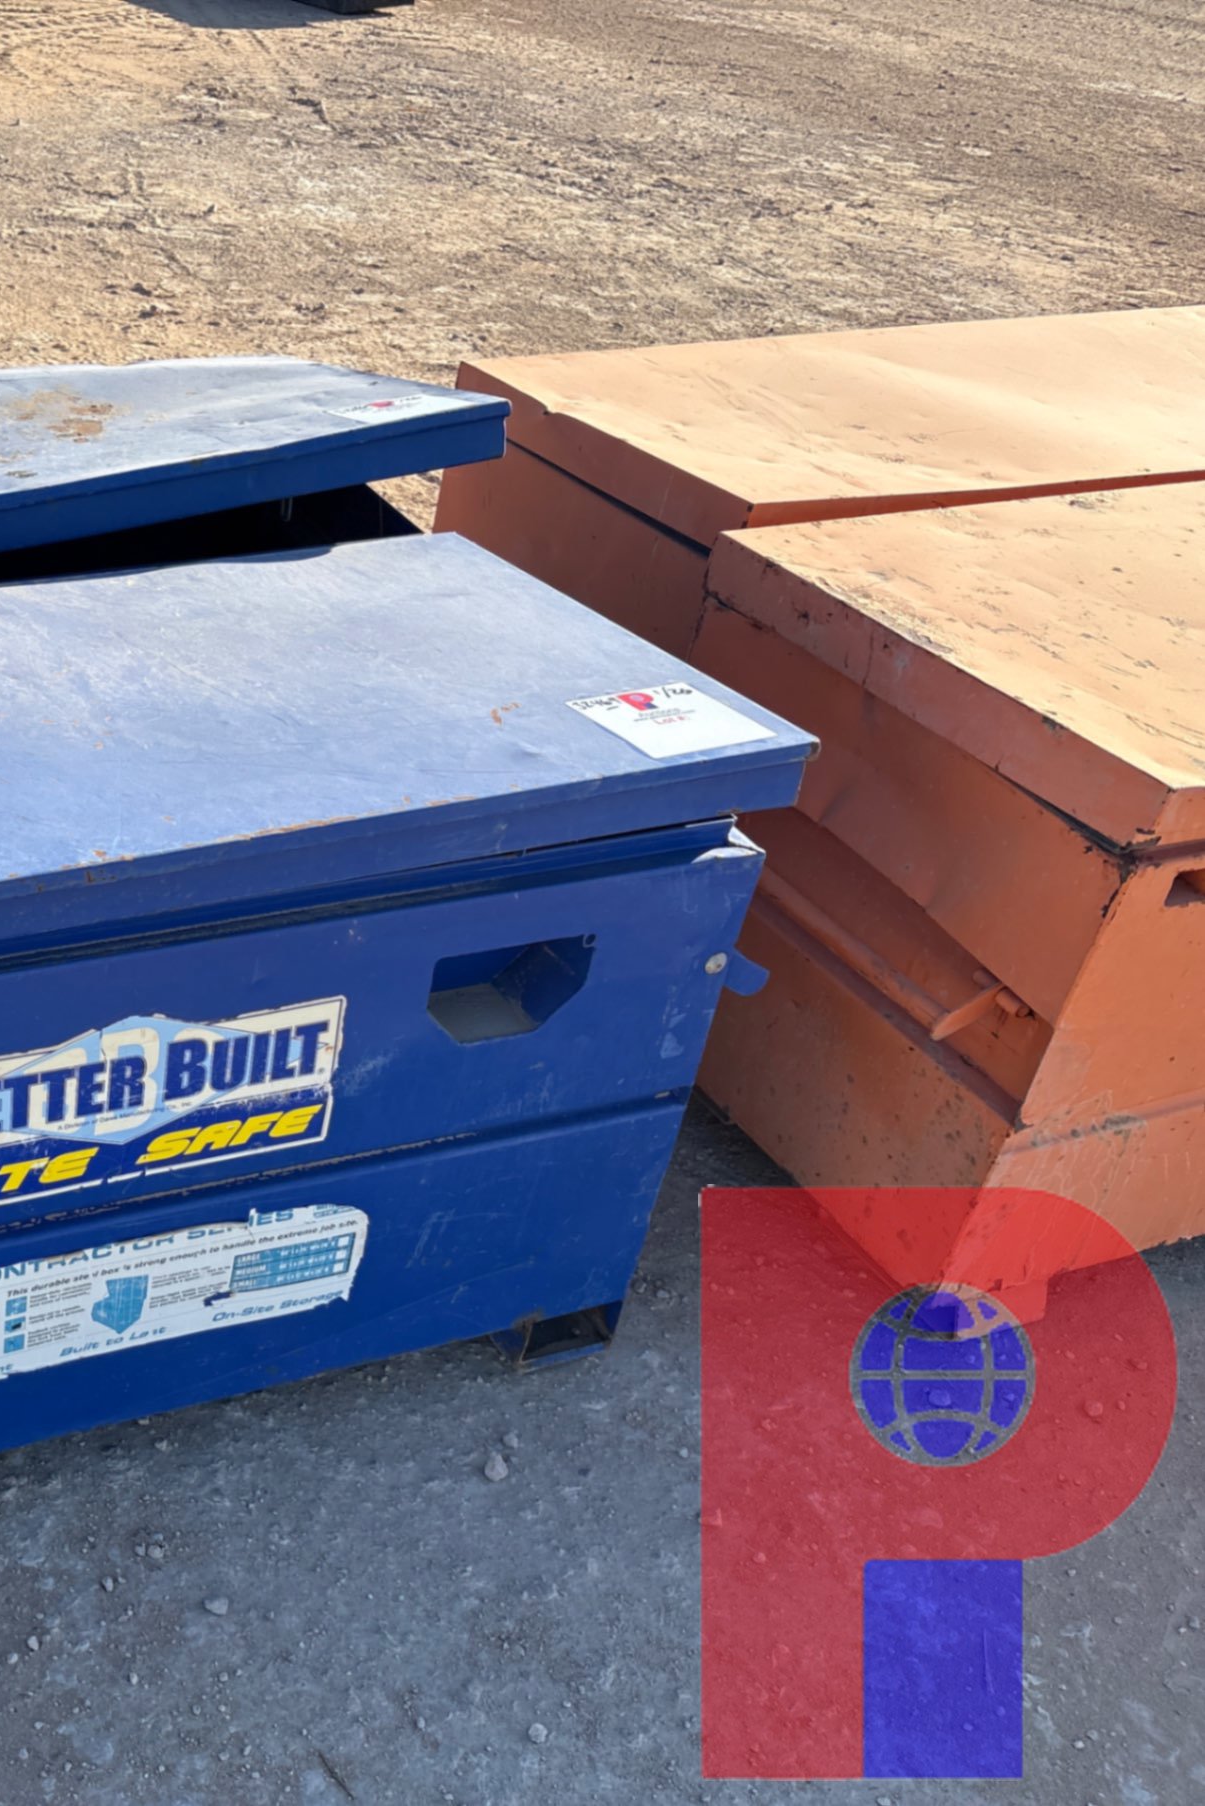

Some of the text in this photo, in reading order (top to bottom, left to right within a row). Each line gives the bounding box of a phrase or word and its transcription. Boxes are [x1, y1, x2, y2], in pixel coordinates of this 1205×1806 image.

[163, 1019, 331, 1103] BUILT
[135, 1104, 324, 1166] SAFE
[7, 1286, 29, 1298] This
[31, 1276, 71, 1291] durable
[134, 1256, 167, 1269] strong
[169, 1249, 208, 1261] enough
[209, 1245, 220, 1254] to
[222, 1238, 256, 1250] handle
[258, 1235, 275, 1244] the
[277, 1228, 318, 1241] extreme
[319, 1223, 337, 1235] job
[212, 1290, 344, 1321] On-Site Storage
[59, 1338, 100, 1357] Built
[105, 1336, 124, 1346] to
